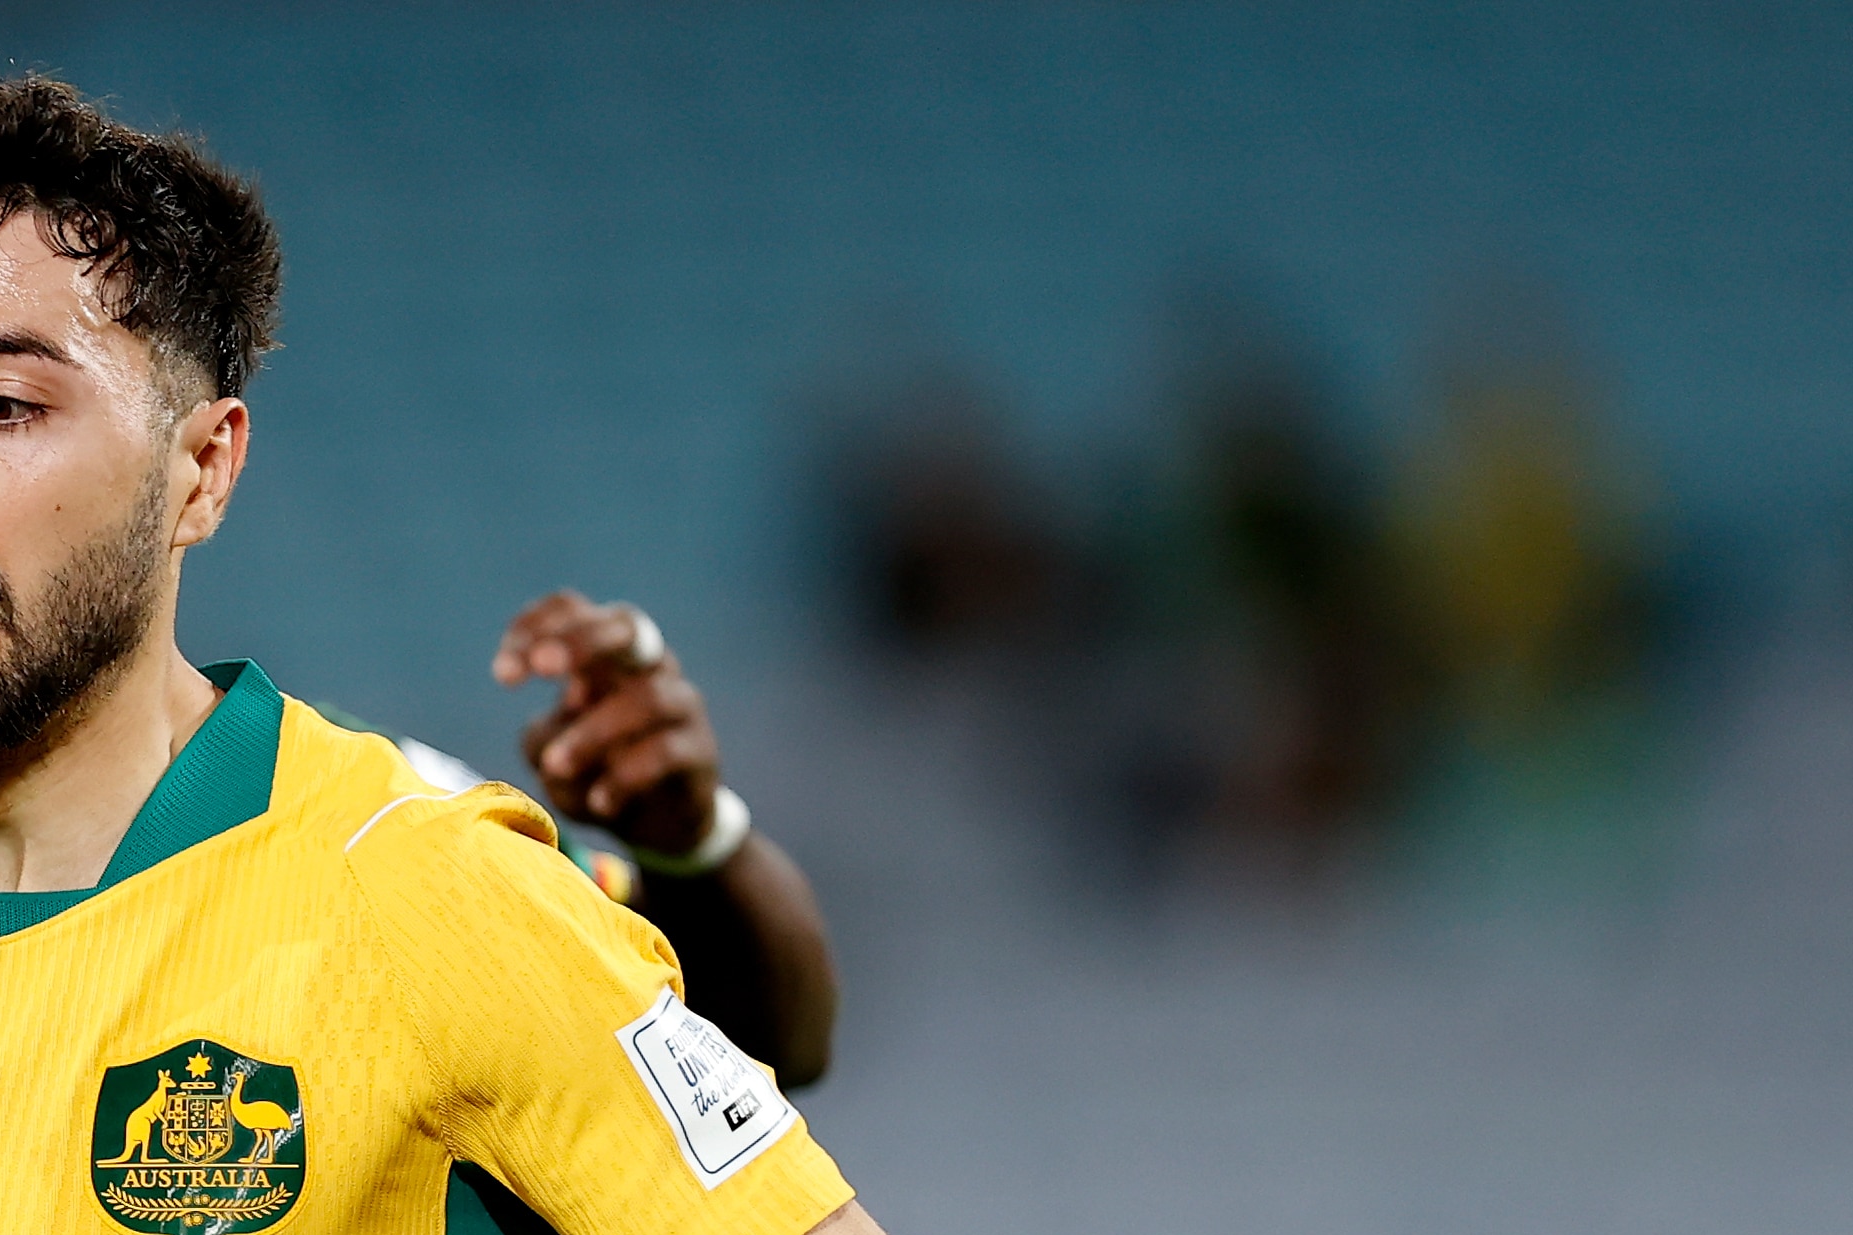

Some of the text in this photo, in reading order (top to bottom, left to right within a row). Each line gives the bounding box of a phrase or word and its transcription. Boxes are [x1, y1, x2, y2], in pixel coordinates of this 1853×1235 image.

[677, 1031, 727, 1087] UNITES
[691, 1087, 720, 1117] the
[727, 1093, 759, 1125] FIFA
[121, 1169, 271, 1188] AUSTRALIA
